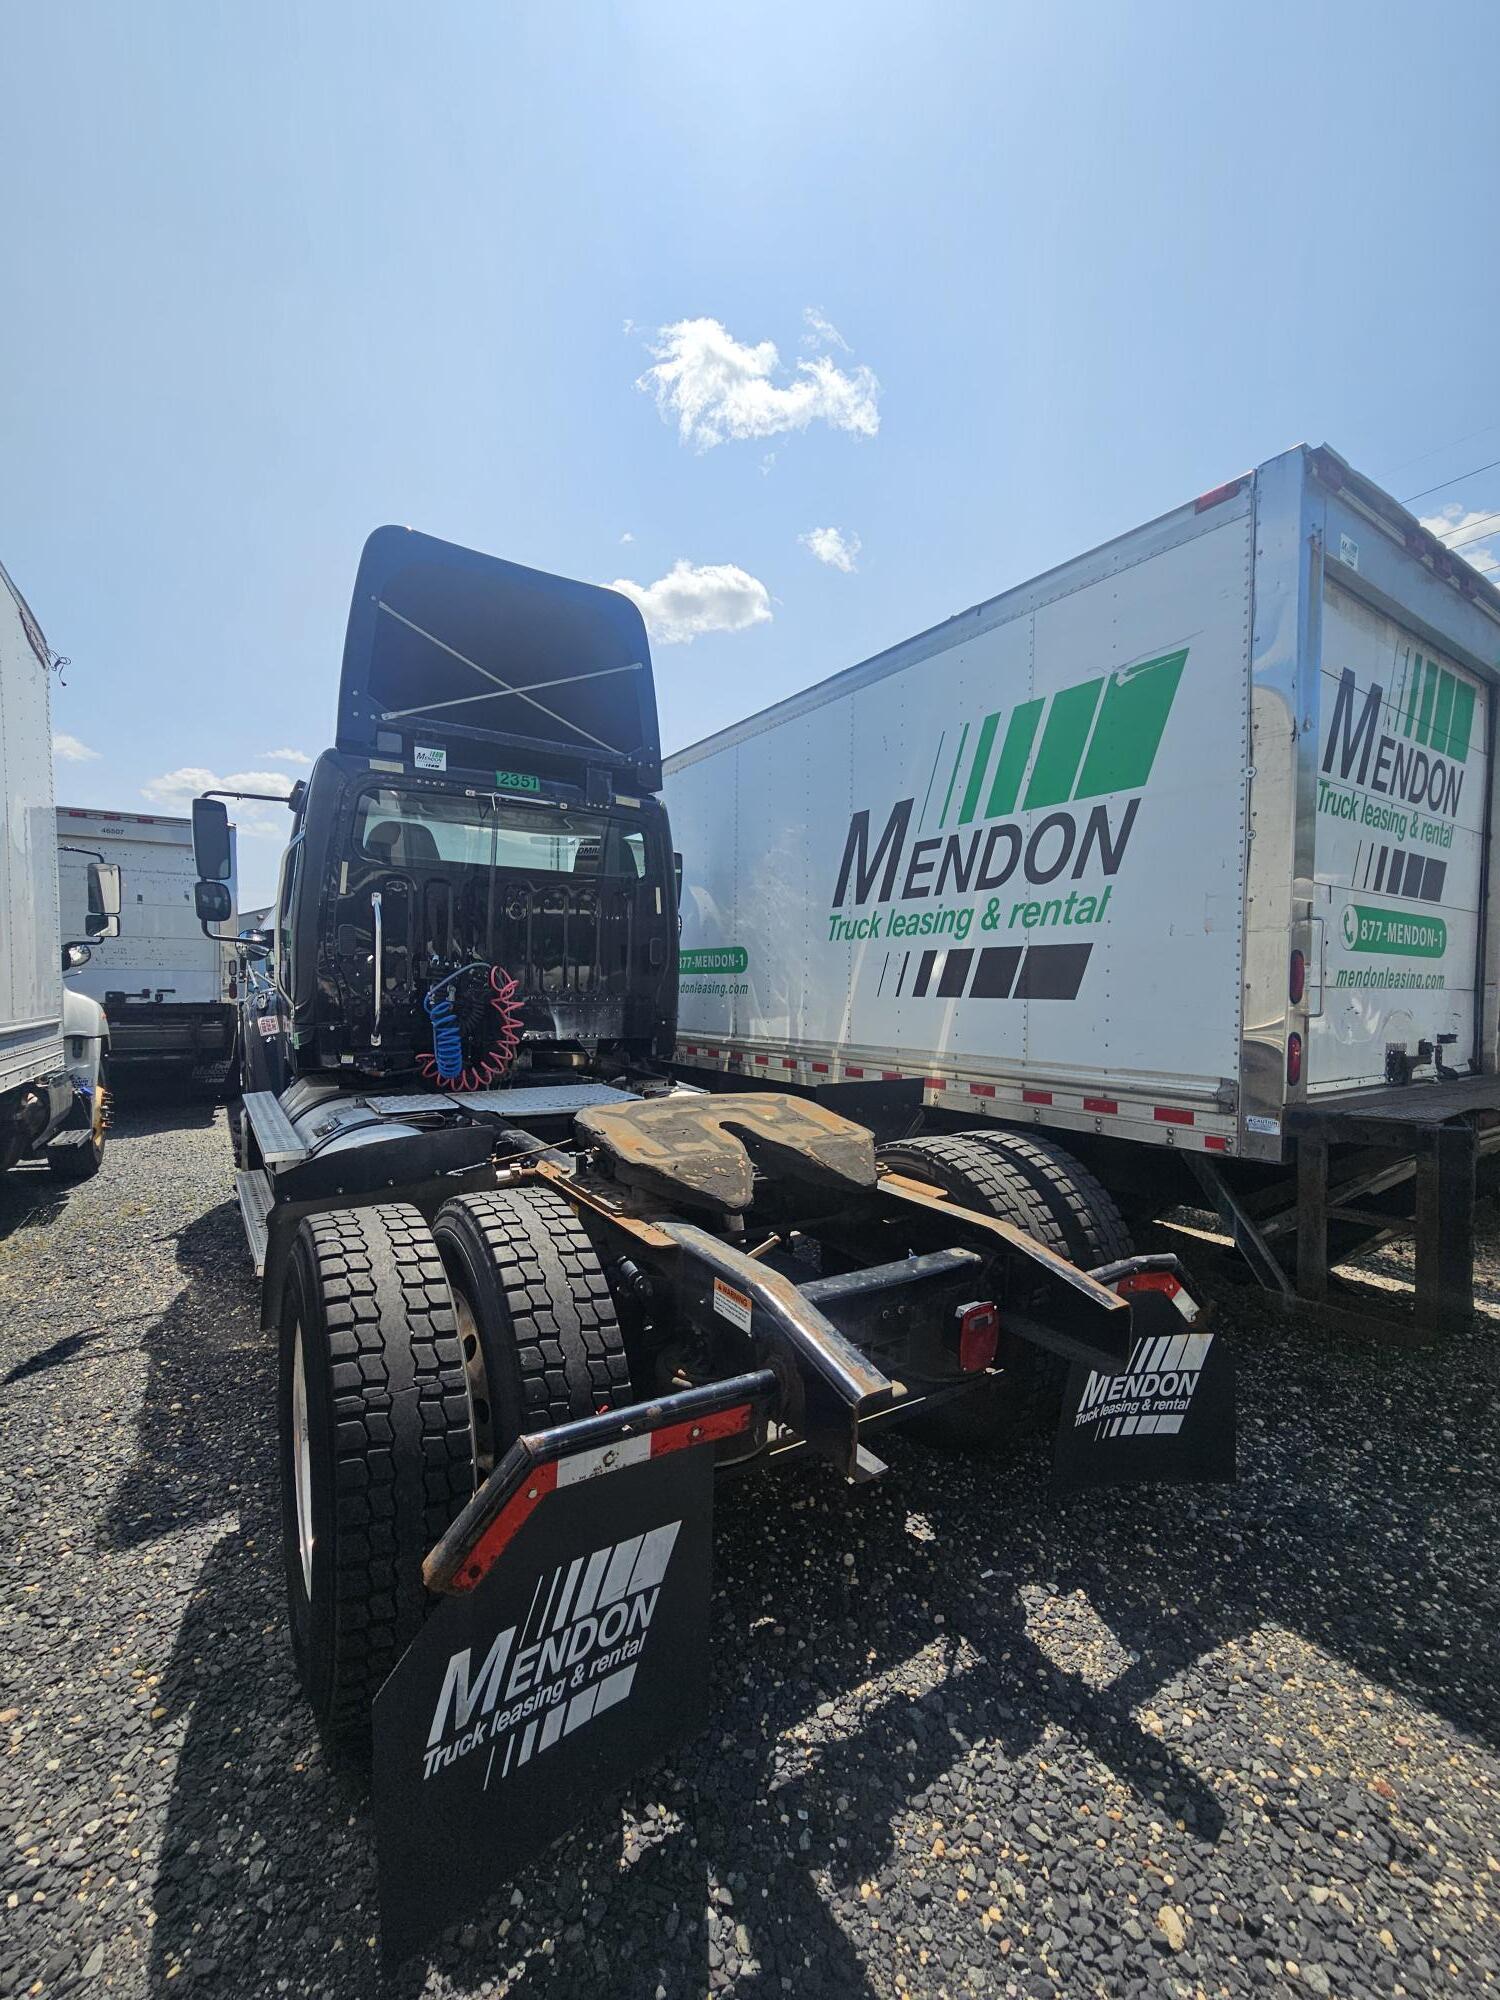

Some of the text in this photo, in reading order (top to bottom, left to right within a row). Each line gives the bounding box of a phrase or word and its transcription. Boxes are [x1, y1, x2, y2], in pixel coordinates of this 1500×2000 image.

[1320, 666, 1465, 818] MENDON
[500, 772, 537, 789] 2351
[1317, 779, 1456, 849] Truck leasing & rental
[832, 798, 1142, 908] MENDON
[828, 884, 1113, 942] Truck leasing & rental
[1360, 919, 1443, 949] 877-MENDON-1
[679, 981, 749, 997] donleasing.com
[1074, 1397, 1192, 1428] Truck leasing & rental
[1077, 1370, 1200, 1413] MENDON
[426, 1587, 661, 1749] MENDON
[423, 1630, 648, 1780] Truck leasing & rental
